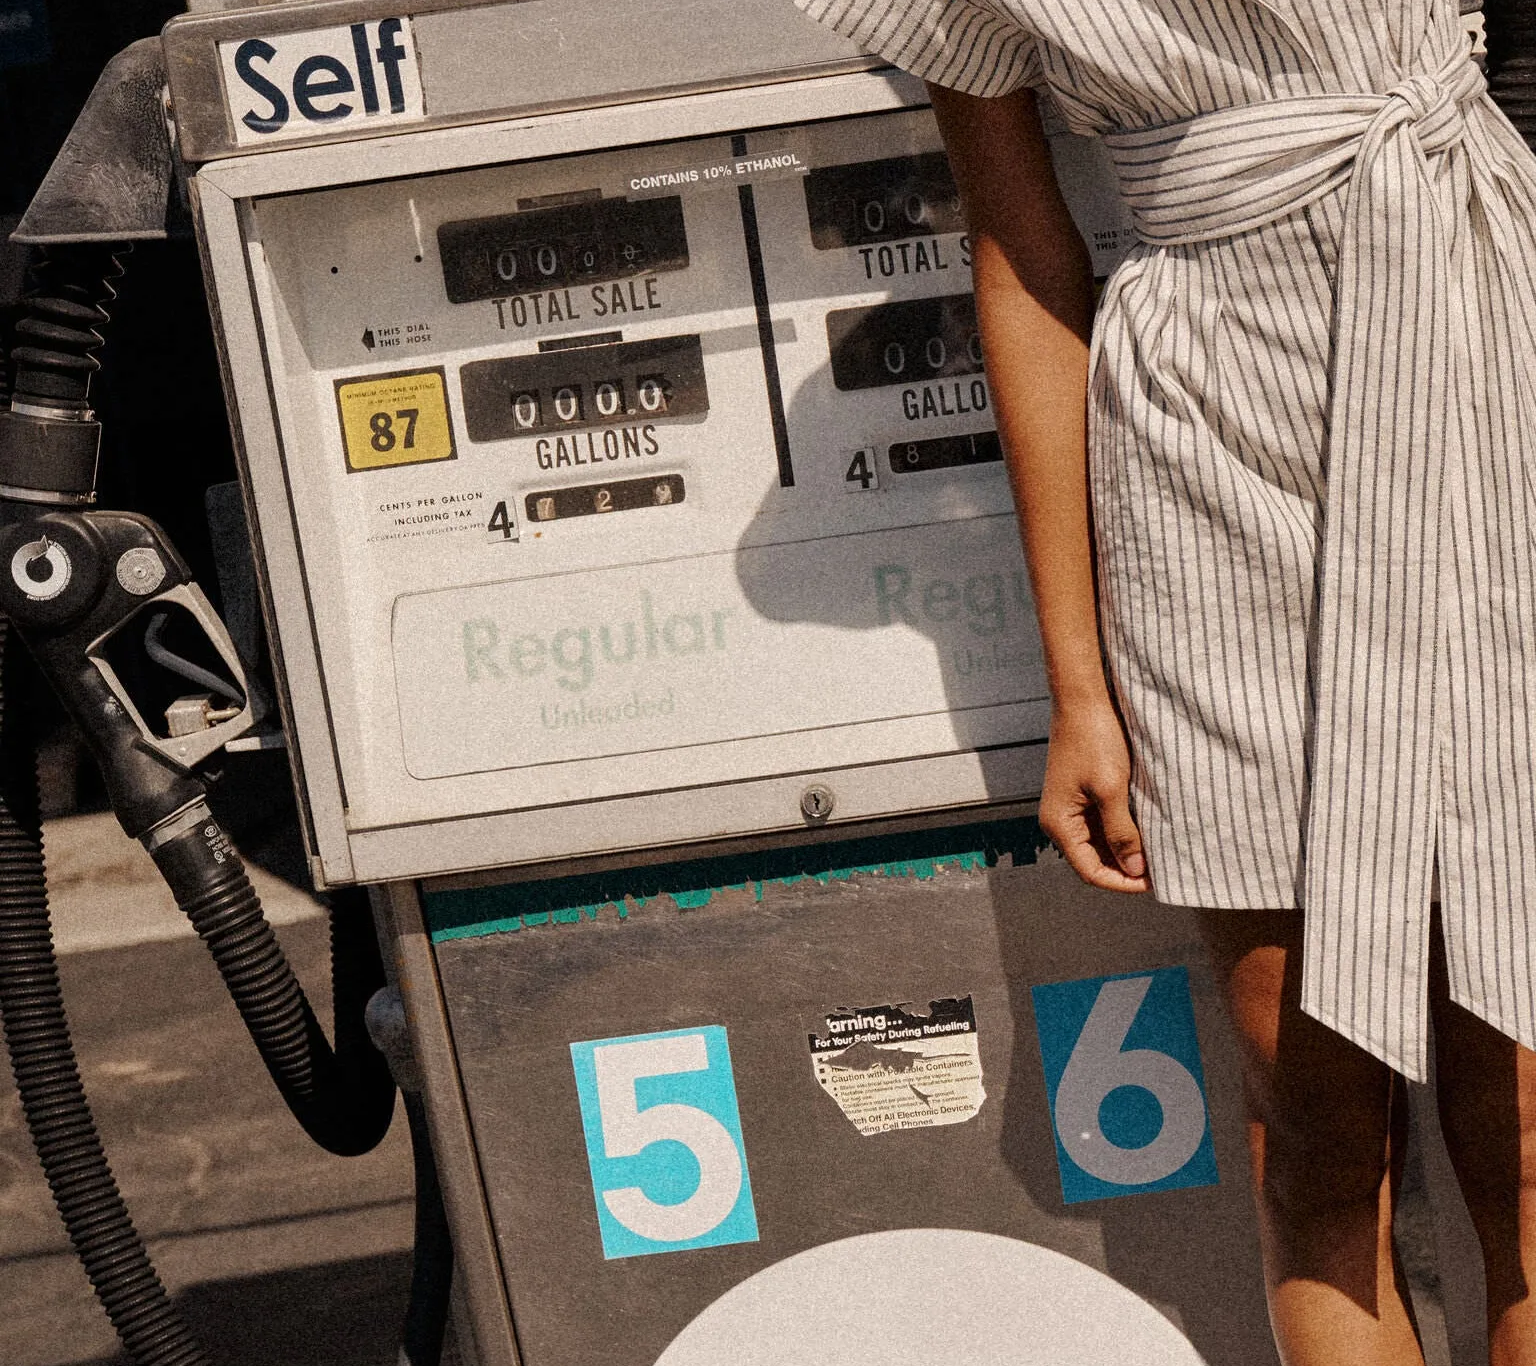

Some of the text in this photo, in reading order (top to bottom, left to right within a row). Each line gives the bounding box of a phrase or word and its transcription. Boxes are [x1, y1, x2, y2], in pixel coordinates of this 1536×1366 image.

[233, 17, 406, 134] Self
[630, 153, 801, 191] CONTAINS 10% ETHANOL
[858, 238, 948, 279] TOTAL
[492, 278, 662, 330] TOTAL SALE
[378, 323, 431, 337] THIS DIAL
[379, 334, 432, 348] THIS HOSE
[369, 408, 420, 453] 87
[535, 424, 660, 470] GALLONS
[846, 450, 874, 489] 4
[379, 491, 483, 512] CENTS PER GALLON
[394, 509, 472, 526] INCLUDING TAX
[487, 500, 515, 540] 4
[463, 589, 737, 692] Regular
[815, 1021, 970, 1049] For Your Safety During Refueling
[826, 1014, 903, 1034] arning...
[831, 1073, 865, 1084] Caution
[867, 1070, 886, 1079] with
[926, 1059, 973, 1072] Containers
[1054, 975, 1207, 1185] 6
[868, 1114, 882, 1124] Off
[884, 1112, 895, 1121] All
[897, 1108, 939, 1120] Electronic
[882, 1122, 899, 1131] Cell
[901, 1118, 934, 1128] Phones
[592, 1034, 742, 1242] 5
